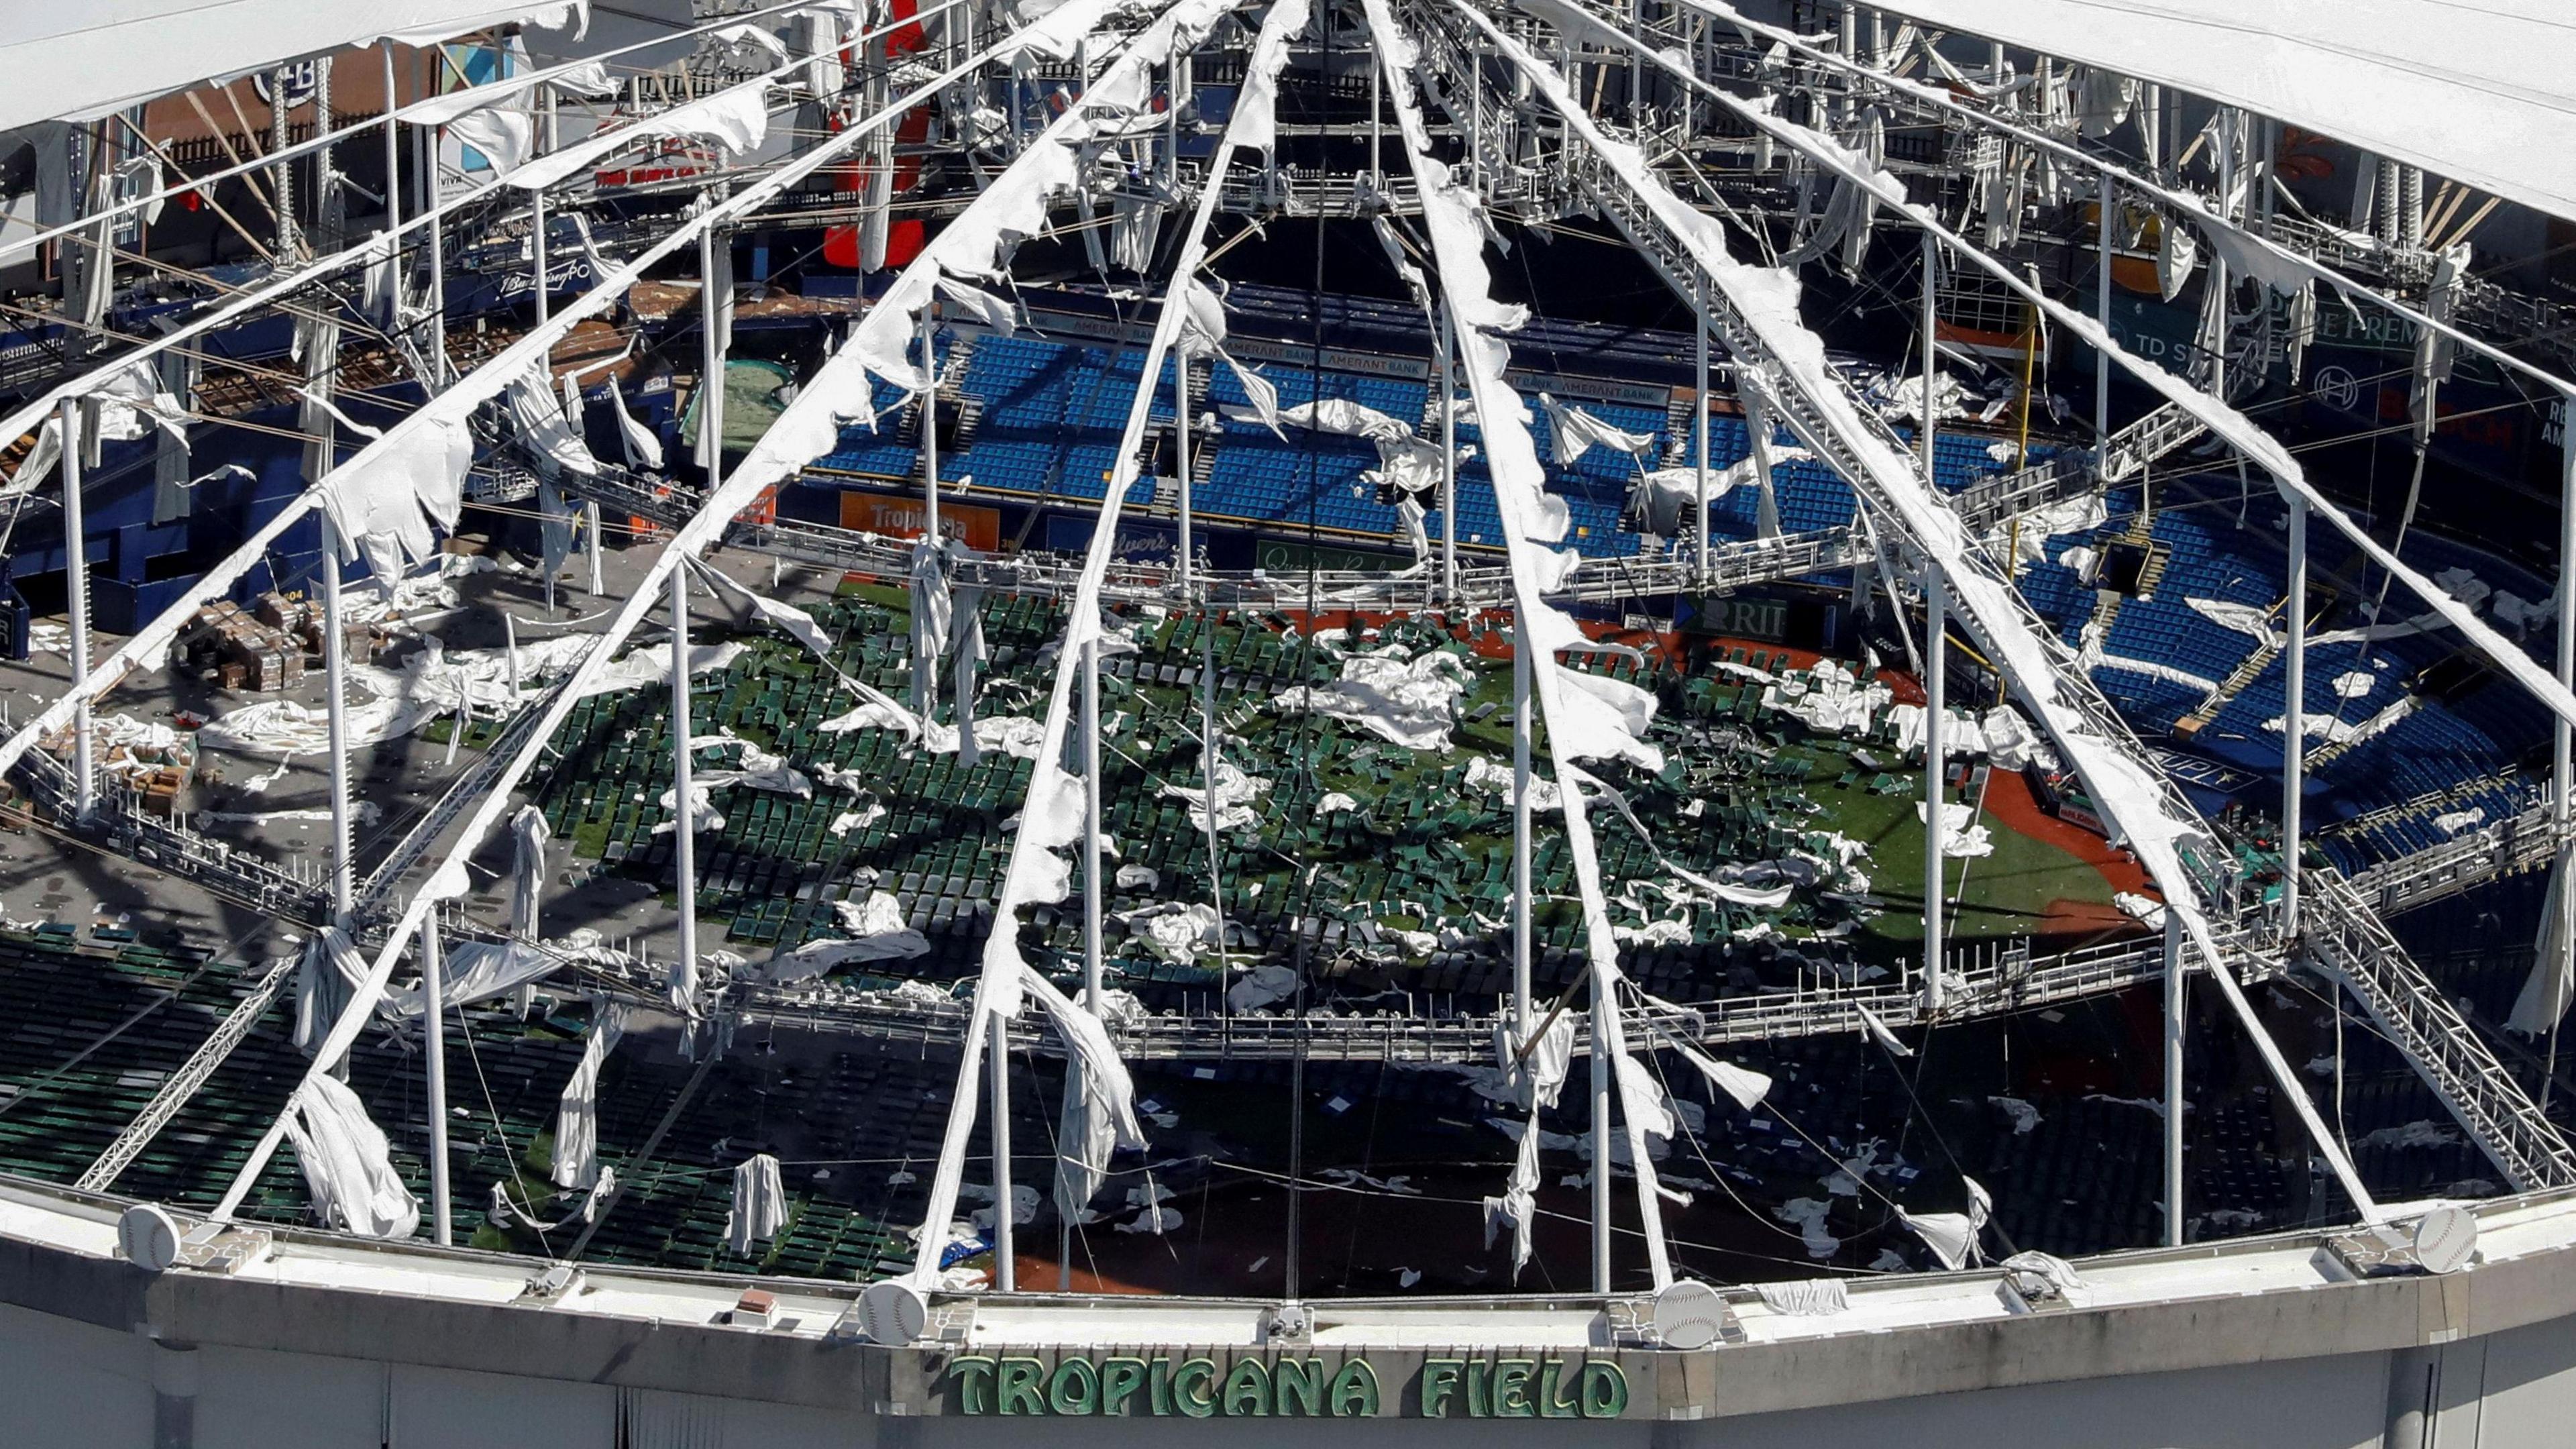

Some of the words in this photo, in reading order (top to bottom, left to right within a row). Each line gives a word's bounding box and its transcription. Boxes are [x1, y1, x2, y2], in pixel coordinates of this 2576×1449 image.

[1226, 341, 1284, 358] AMERANT
[2135, 333, 2165, 356] TD
[1328, 354, 1387, 371] AMERANT
[1388, 362, 1419, 374] BANK
[1562, 382, 1621, 398] AMERANT
[1623, 390, 1654, 402] BANK
[870, 503, 967, 539] Tropina
[949, 1356, 1380, 1418] TROPICANA
[1421, 1358, 1629, 1419] FIELD
